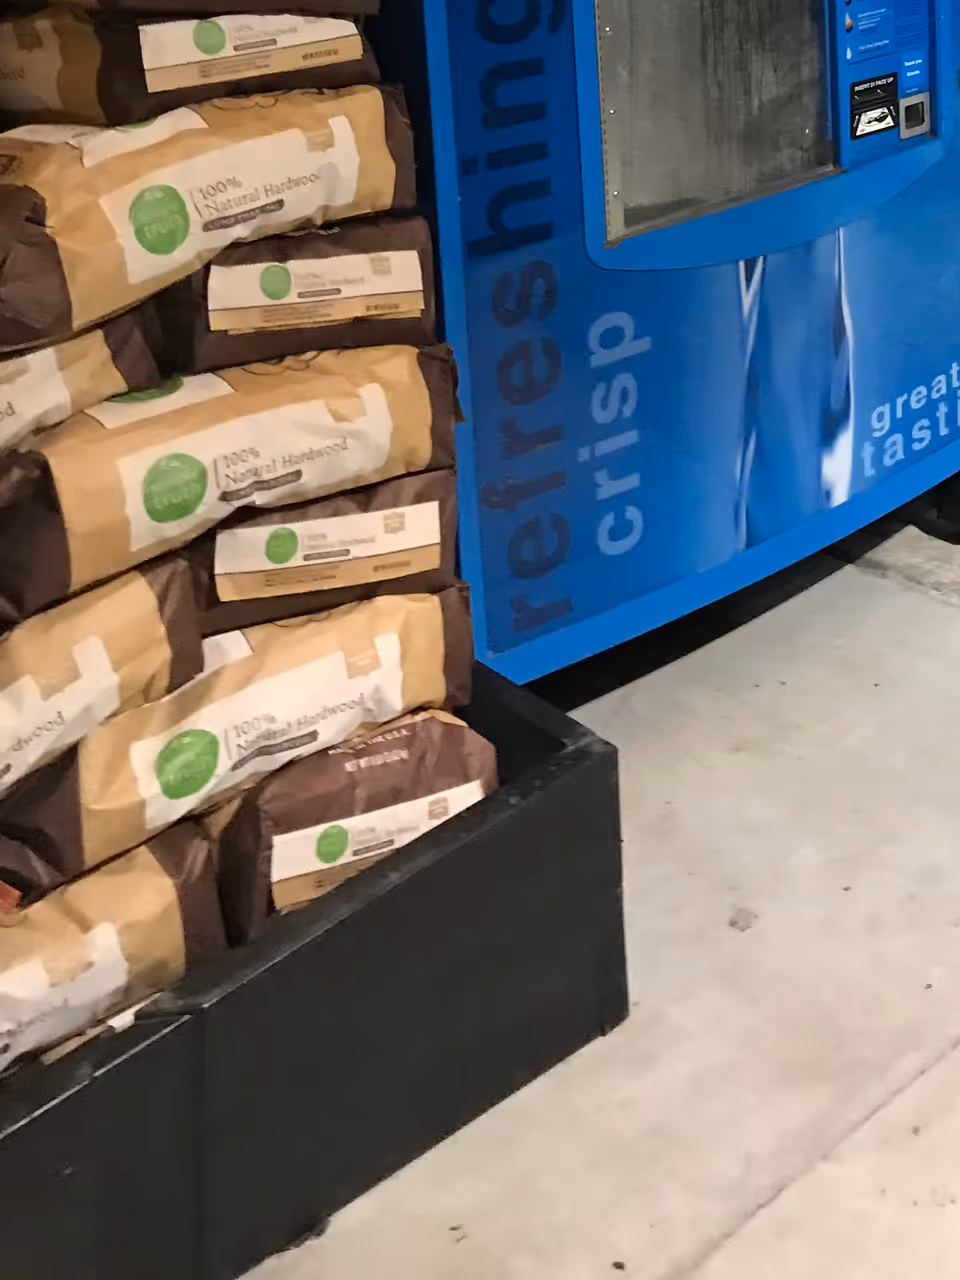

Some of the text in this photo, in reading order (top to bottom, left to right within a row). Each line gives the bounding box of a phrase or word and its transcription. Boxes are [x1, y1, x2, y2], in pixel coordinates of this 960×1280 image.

[199, 175, 243, 200] 100%
[203, 187, 261, 216] Natural
[264, 172, 320, 199] Hardwoo
[870, 361, 960, 438] great
[281, 436, 350, 468] Hardwood
[577, 310, 653, 556] crisp
[221, 446, 261, 469] 100%
